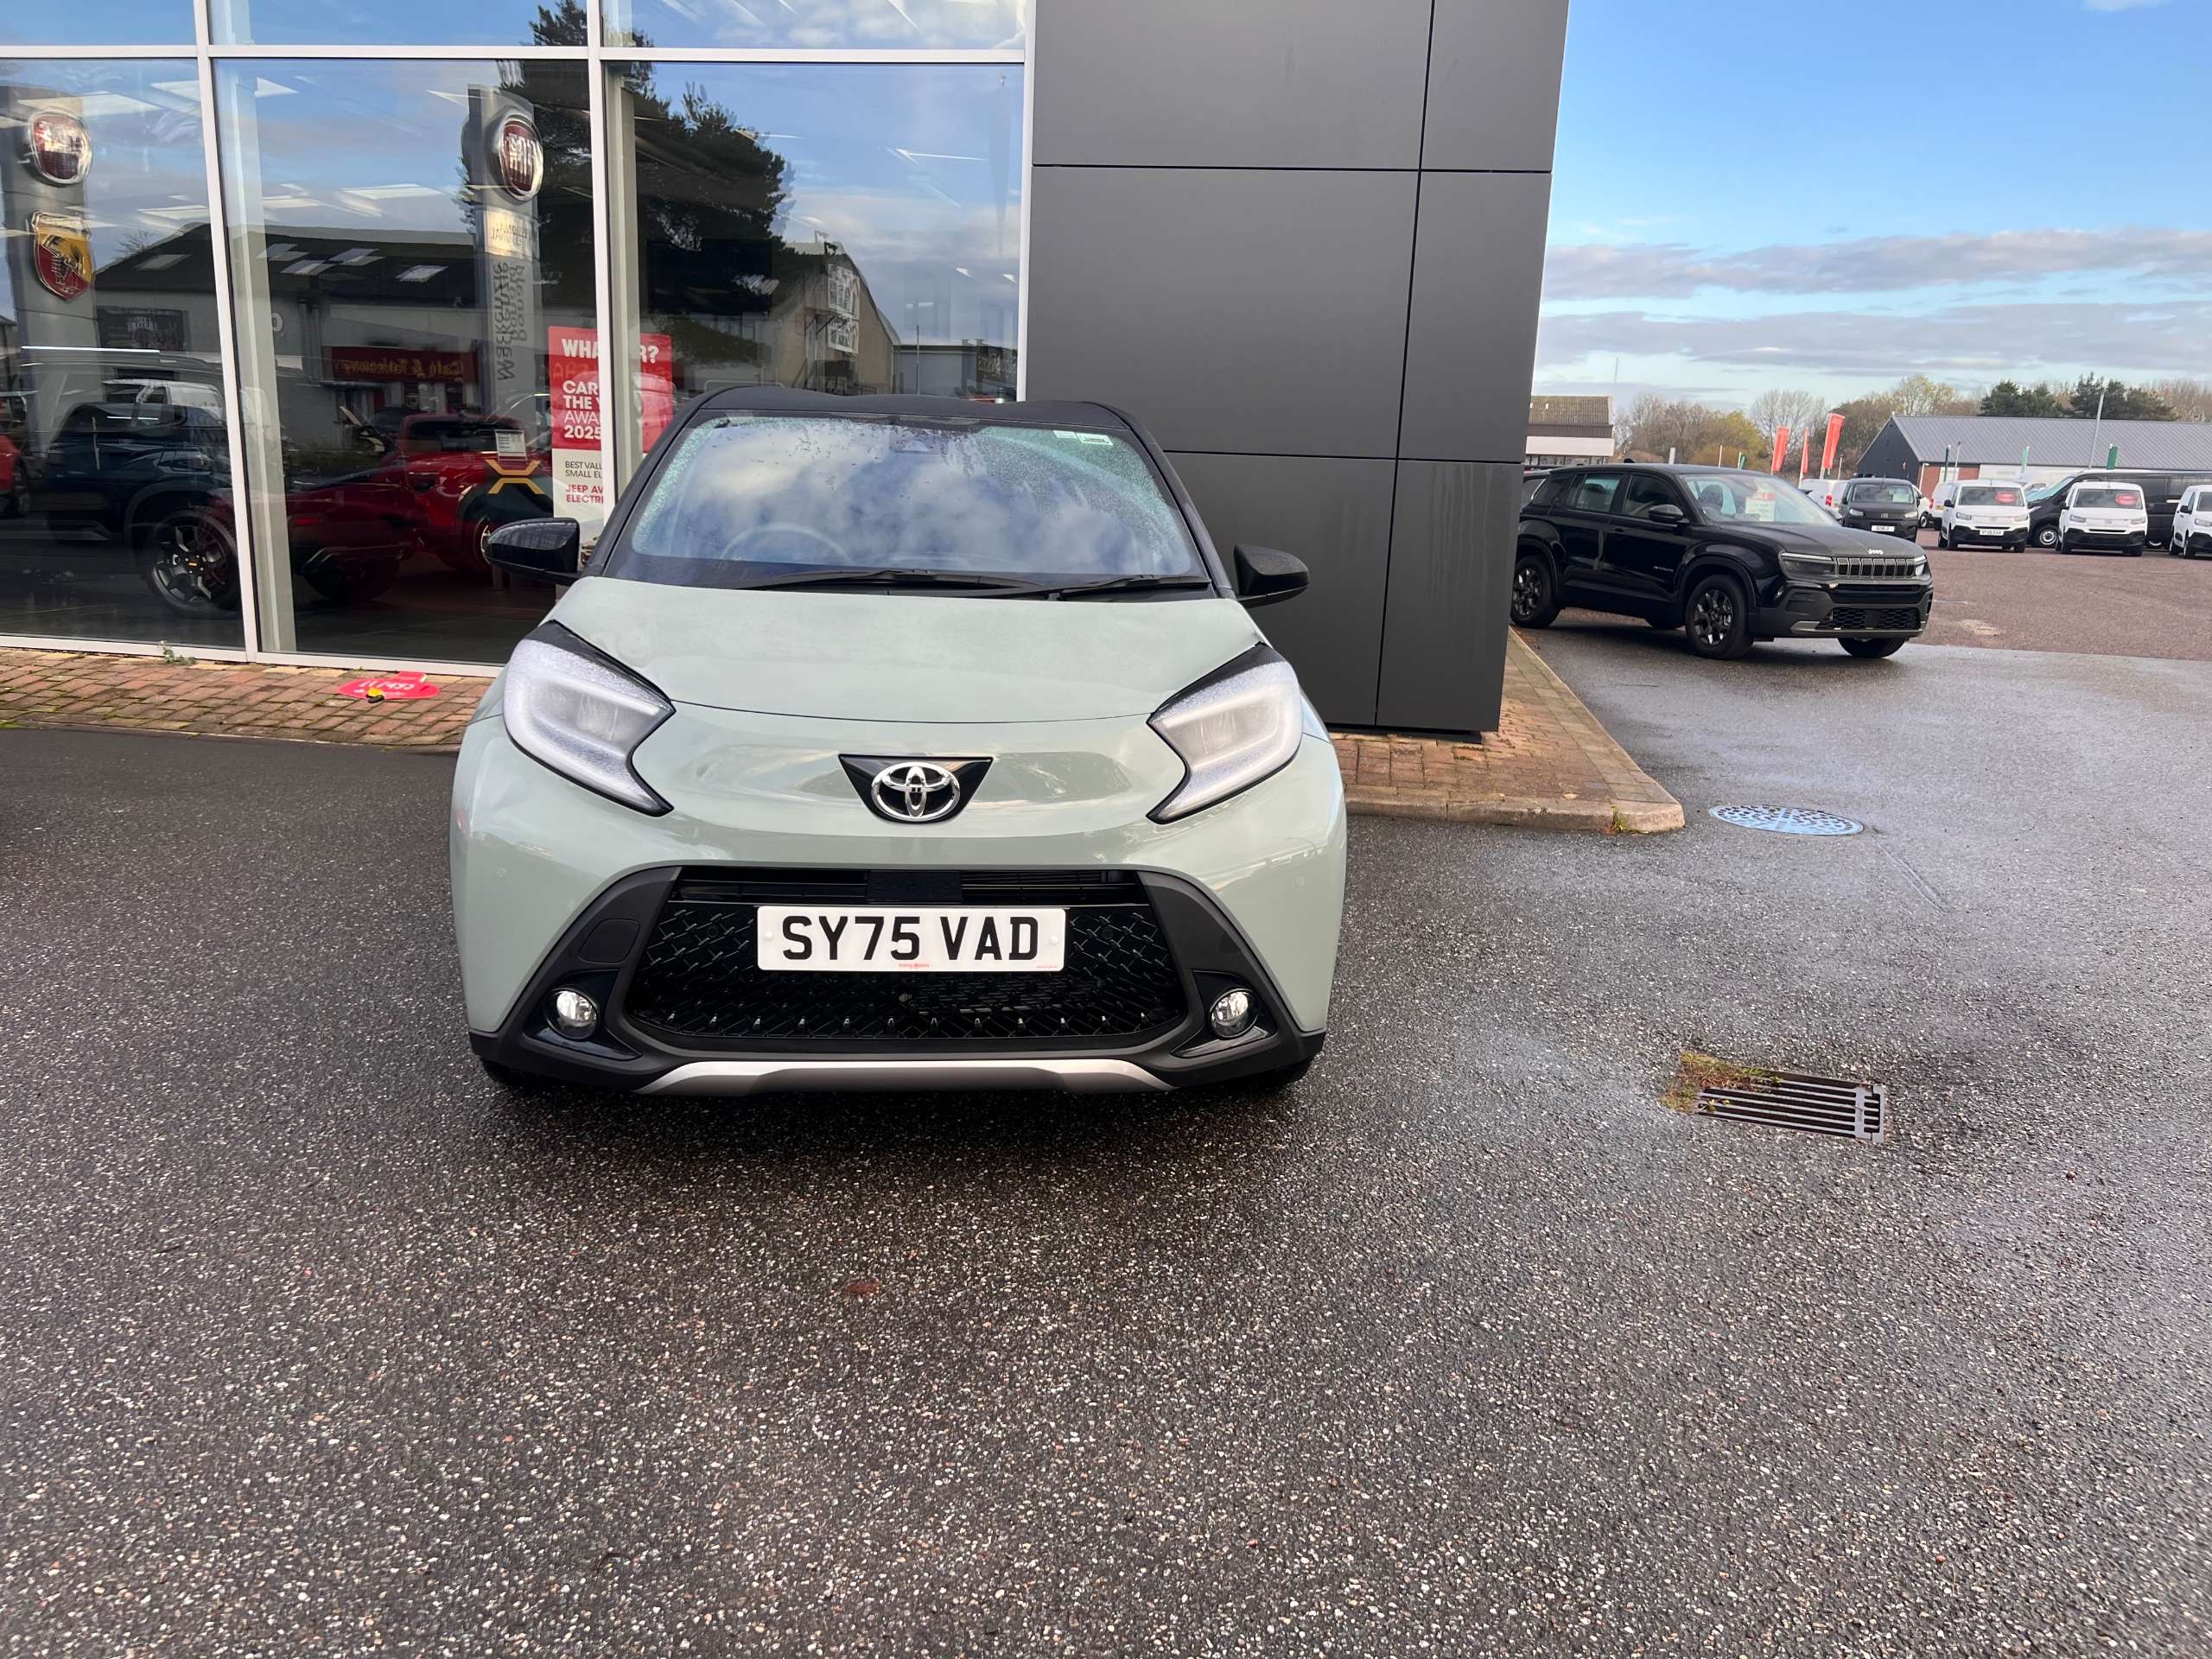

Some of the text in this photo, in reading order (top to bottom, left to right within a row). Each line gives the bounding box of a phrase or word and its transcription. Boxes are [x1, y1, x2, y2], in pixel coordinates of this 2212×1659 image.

[561, 338, 659, 364] WHA R?
[563, 380, 599, 395] CAR
[563, 395, 594, 410] THE
[564, 410, 600, 425] AWA
[563, 424, 601, 440] 2025
[565, 461, 582, 469] BEST
[565, 469, 592, 478] SMALL
[565, 484, 588, 493] JEEP
[566, 494, 604, 504] ELECTRI
[781, 915, 1039, 961] SY75 VAD
